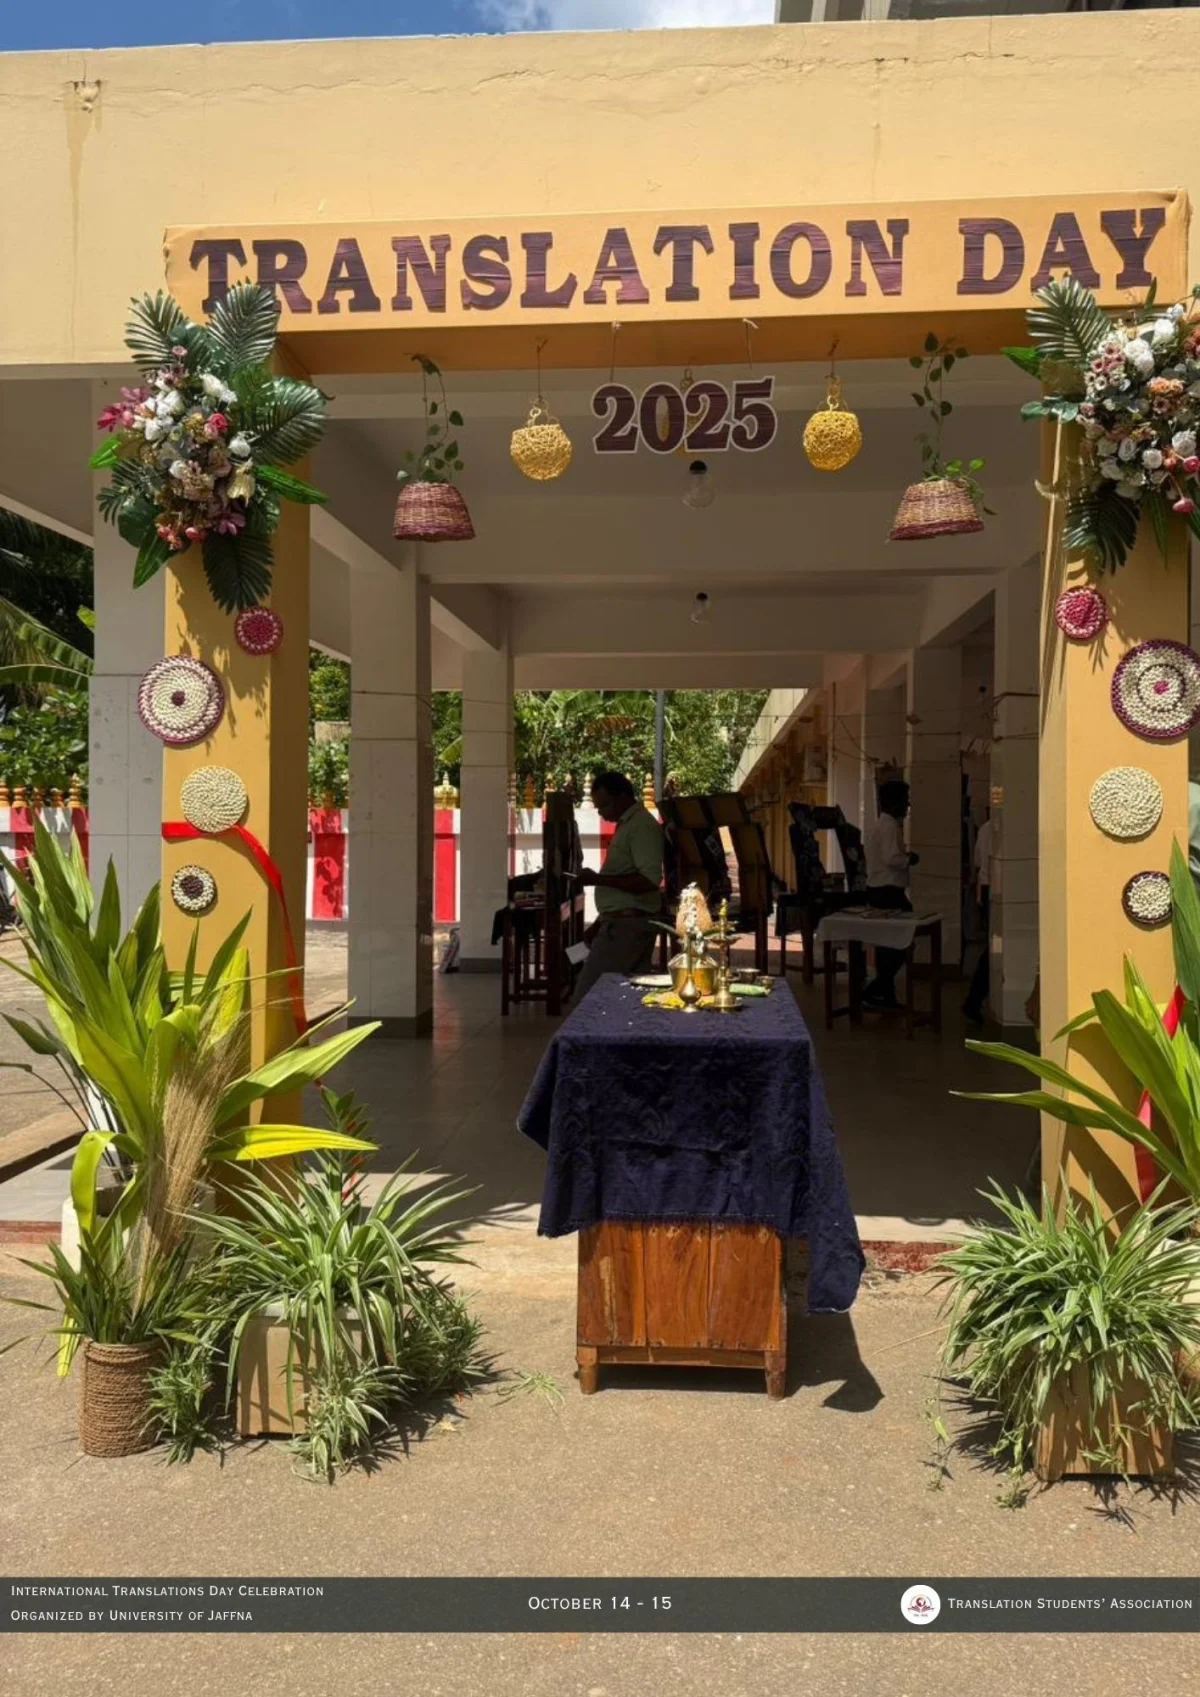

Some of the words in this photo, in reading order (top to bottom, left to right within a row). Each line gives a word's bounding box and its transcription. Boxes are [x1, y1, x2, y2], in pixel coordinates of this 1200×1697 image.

[189, 218, 909, 315] TRANSLATION
[957, 207, 1166, 296] DAY
[591, 376, 777, 454] 2025
